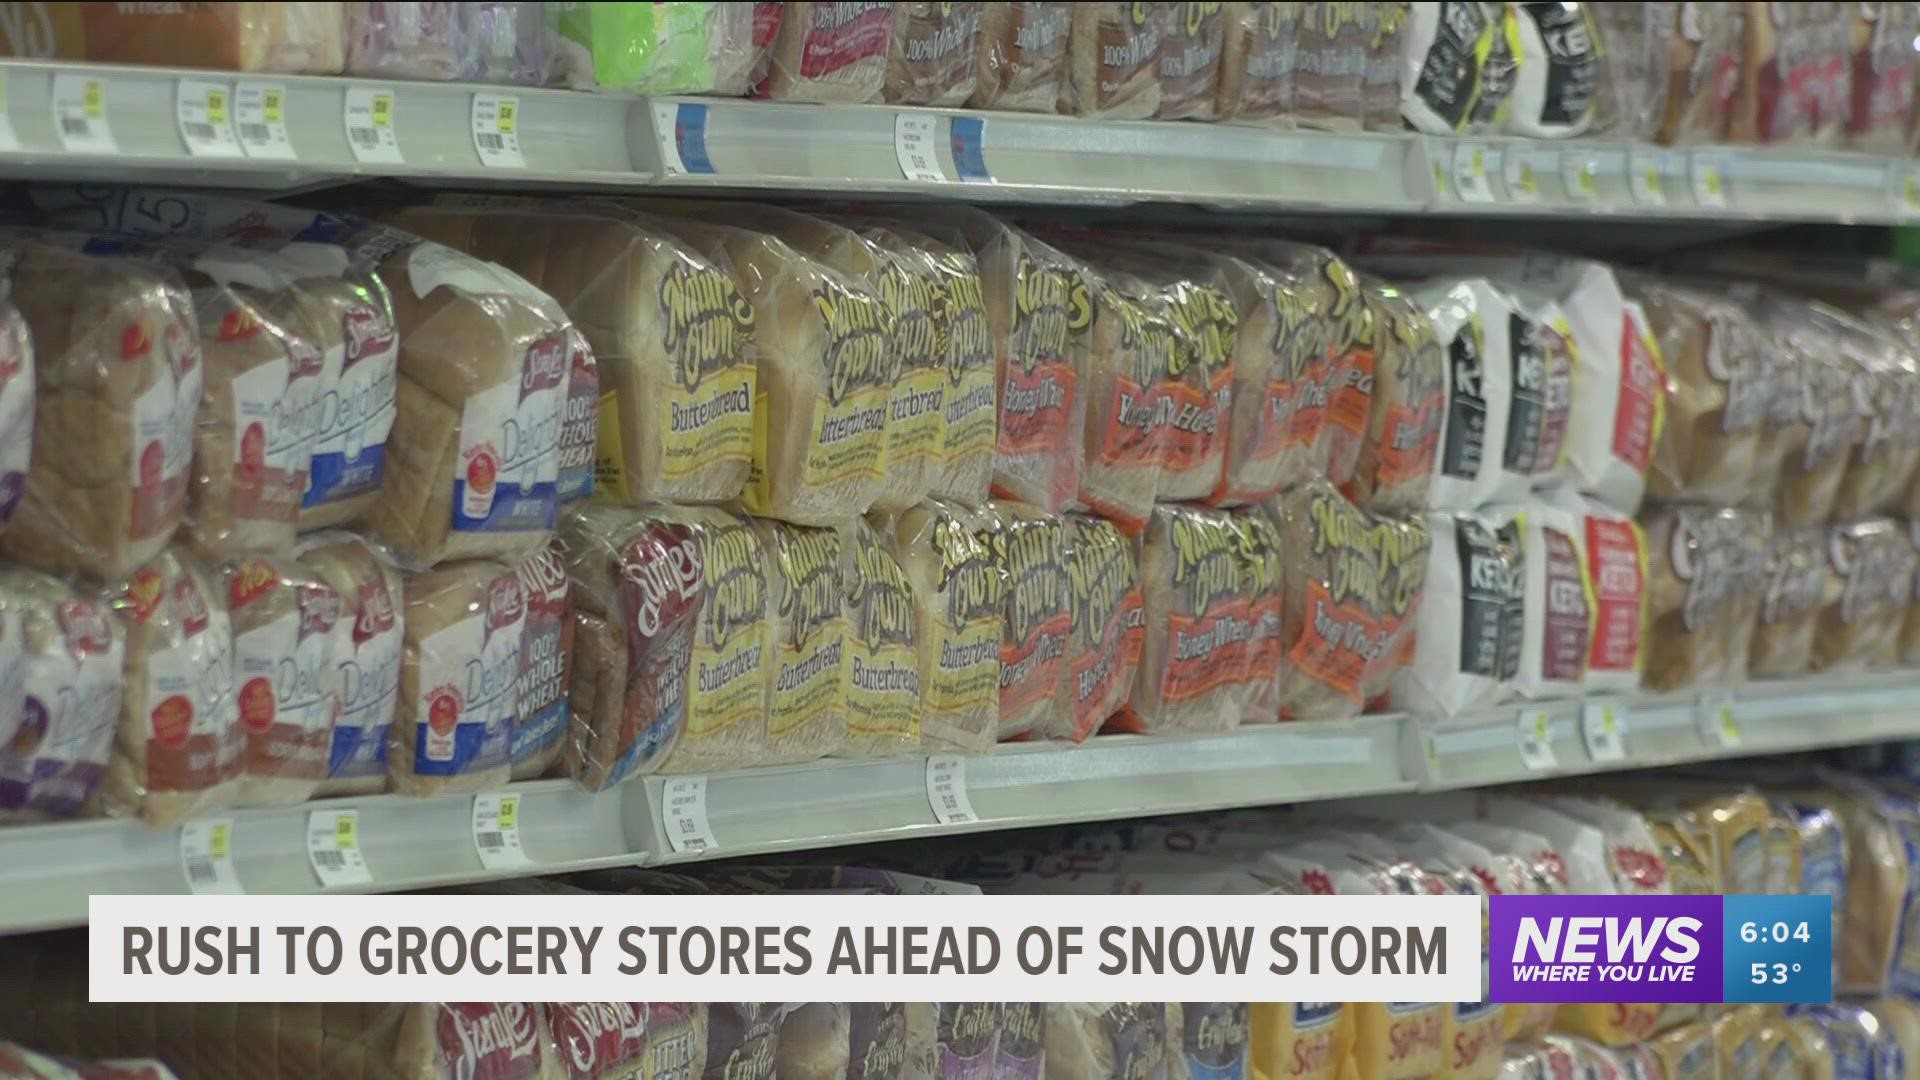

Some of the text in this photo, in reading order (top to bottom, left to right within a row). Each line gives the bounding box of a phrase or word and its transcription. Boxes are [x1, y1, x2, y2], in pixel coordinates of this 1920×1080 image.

[671, 382, 751, 432] Butterbread
[1175, 629, 1214, 662] Honey
[517, 652, 567, 697] WHOLE
[517, 677, 562, 723] WHEAT
